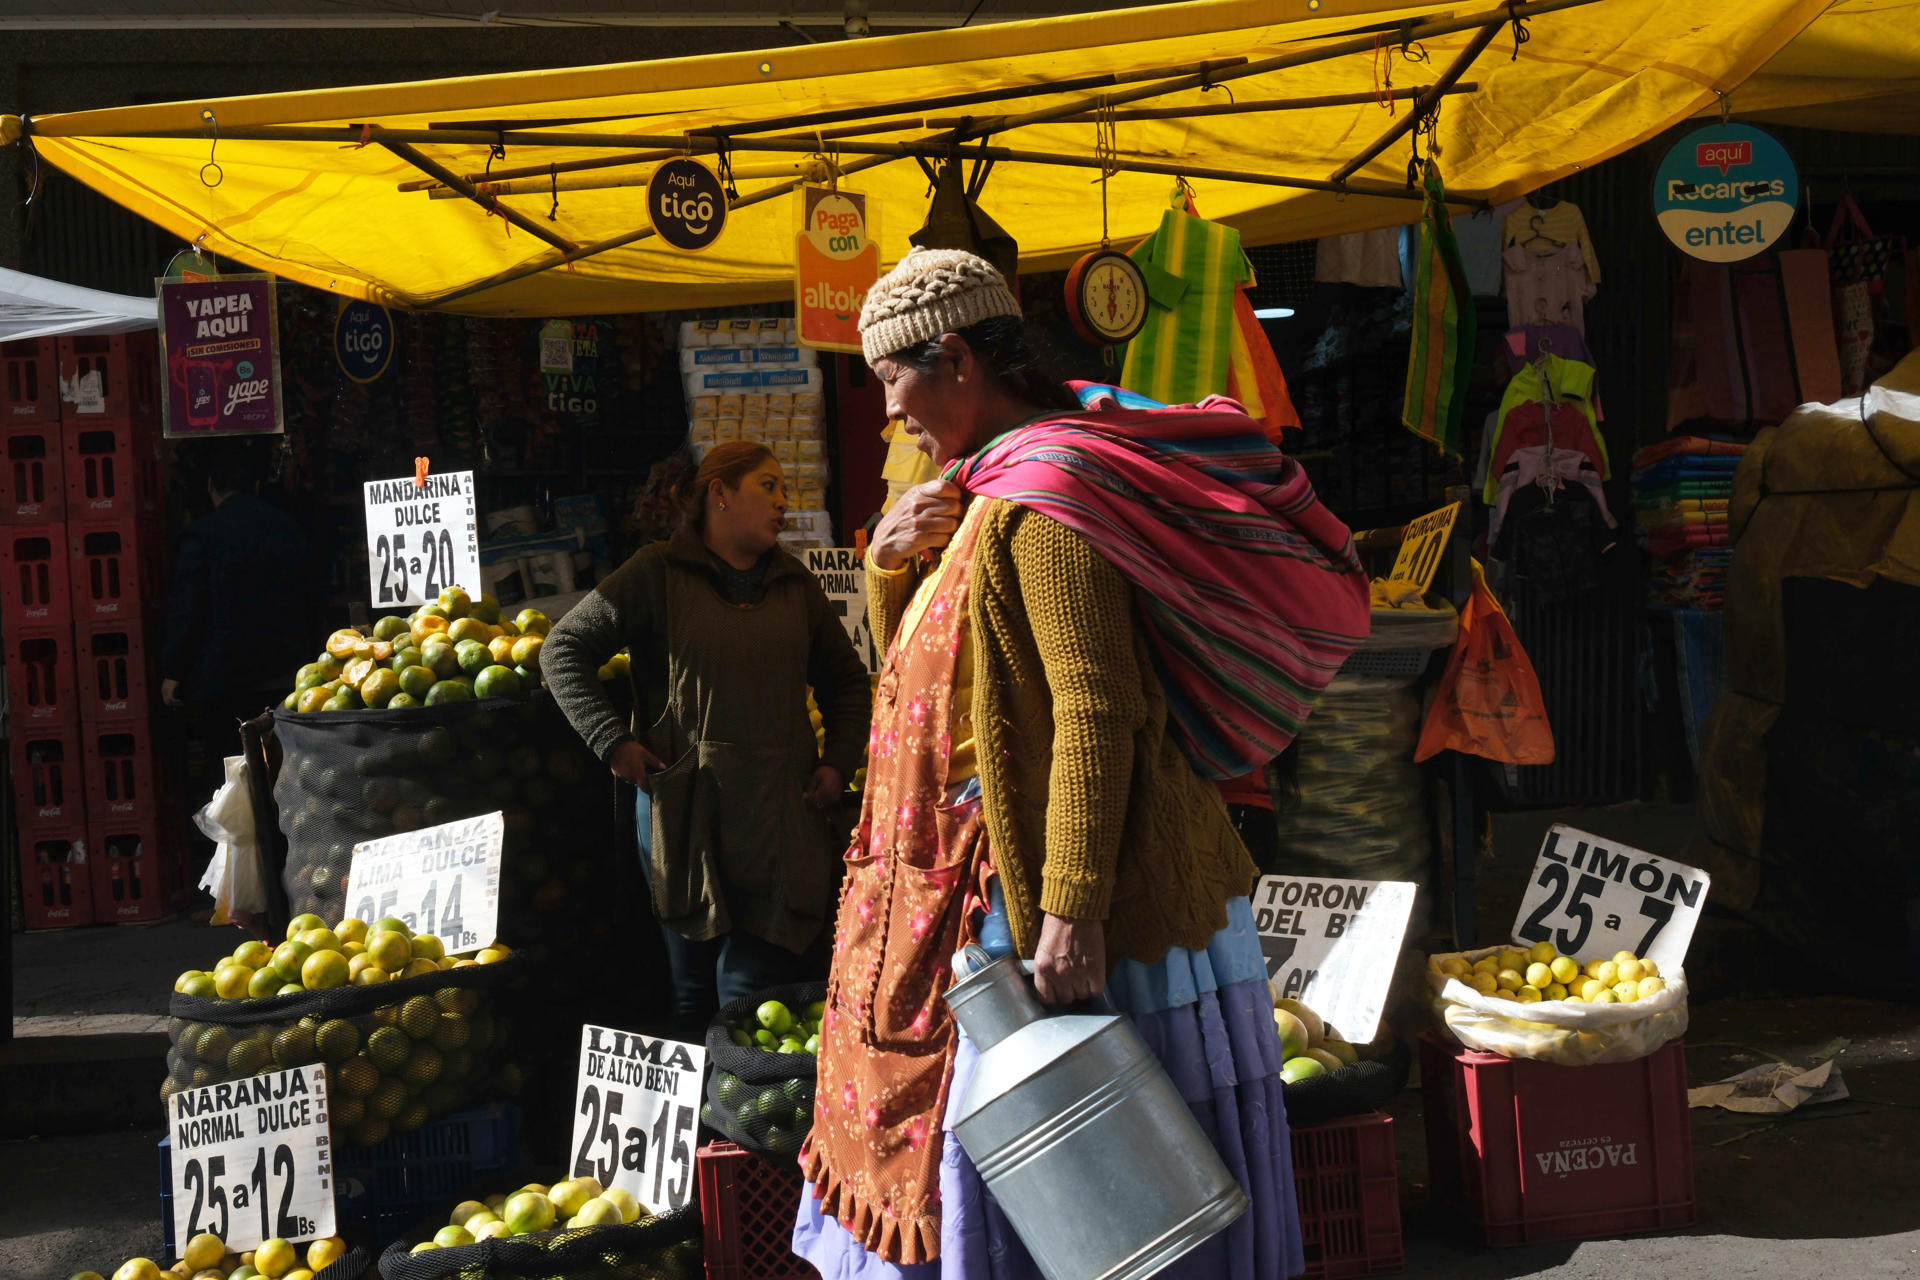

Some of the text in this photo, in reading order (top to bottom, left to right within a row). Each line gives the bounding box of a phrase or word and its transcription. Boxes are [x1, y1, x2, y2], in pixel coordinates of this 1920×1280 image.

[1705, 143, 1743, 164] aquí
[668, 171, 695, 190] Aquí
[1667, 179, 1785, 203] Recargas
[660, 192, 714, 222] tigo
[817, 210, 859, 235] Paga
[829, 235, 859, 252] con
[1685, 219, 1766, 247] entel
[186, 292, 254, 318] YAPEA
[804, 281, 869, 312] altok
[196, 311, 249, 339] AQUÍ
[350, 309, 370, 324] Aquí
[345, 328, 383, 352] tigo
[223, 379, 269, 416] yape
[369, 474, 462, 505] MANDARINA
[394, 502, 441, 528] DULCE
[464, 475, 477, 564] ALTO BENI
[376, 529, 455, 603] 25 a 20
[809, 551, 865, 571] NARA
[1408, 530, 1443, 587] 10
[357, 842, 488, 890] LIMA DULCE
[1542, 831, 1704, 909] LIMÓN
[1266, 880, 1373, 911] TORON
[1518, 862, 1675, 960] 25 a 7
[421, 874, 464, 950] 14
[462, 931, 478, 947] Bs
[1256, 907, 1307, 936] DEL
[587, 1027, 698, 1073] LIMA
[586, 1052, 680, 1096] DE ALTO BENI
[177, 1068, 309, 1120] NARANJA
[178, 1098, 311, 1150] NORMAL DULCE
[313, 1069, 331, 1190] ALTO BENI
[573, 1084, 695, 1210] 25 a 15
[1535, 1142, 1638, 1179] PACEÑA
[184, 1143, 316, 1248] 25 a 12 Bs
